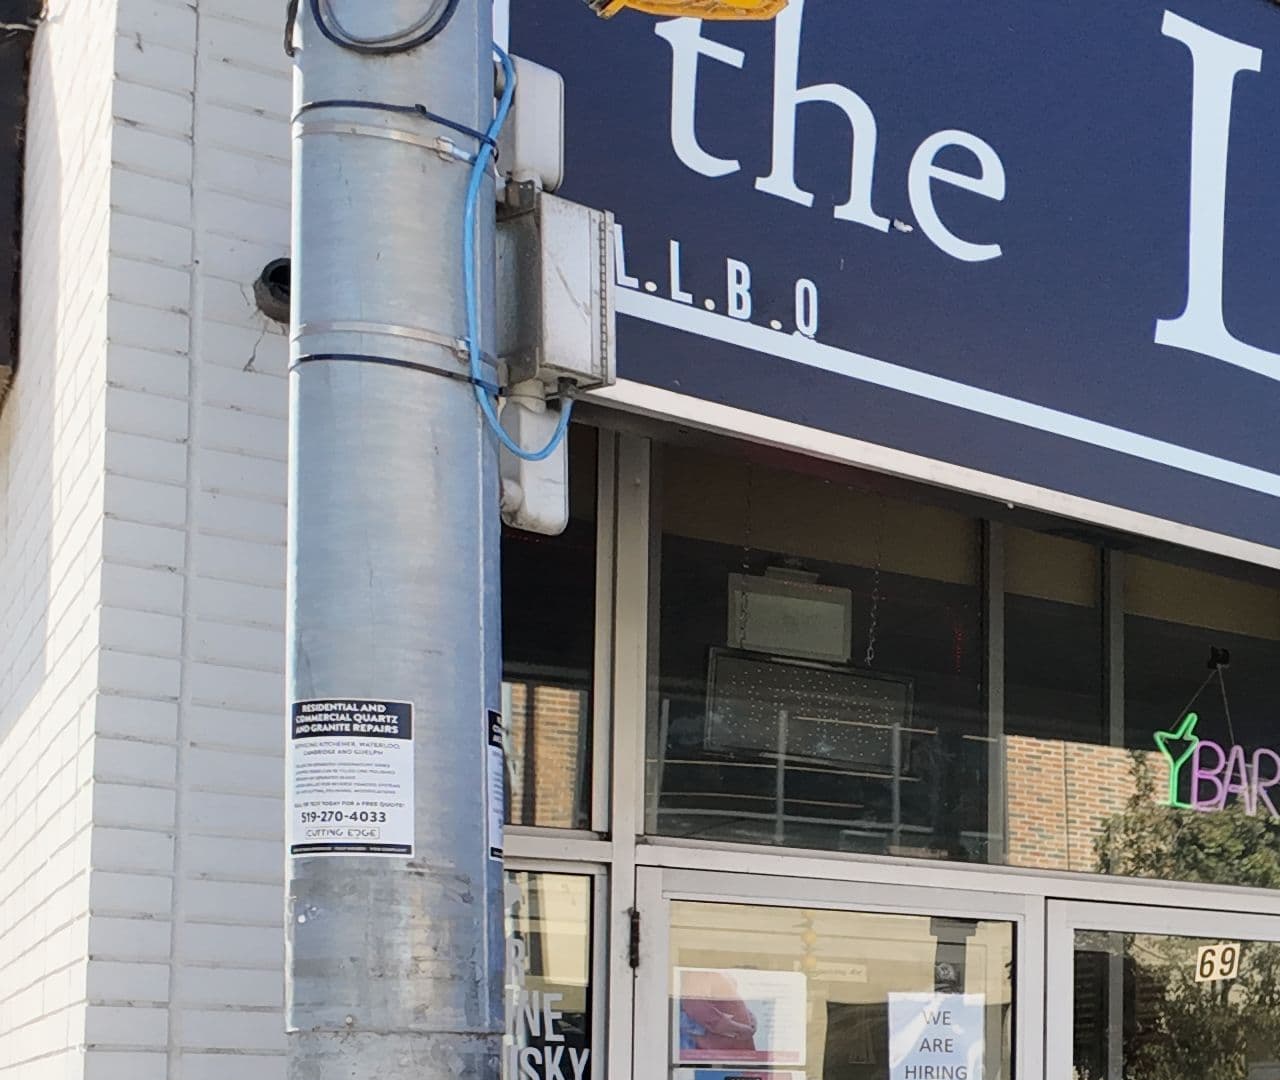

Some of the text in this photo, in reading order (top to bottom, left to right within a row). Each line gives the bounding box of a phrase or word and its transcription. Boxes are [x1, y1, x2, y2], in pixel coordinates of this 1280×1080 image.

[654, 0, 1006, 262] the
[302, 704, 387, 713] RESIDENTIAL AND
[296, 714, 398, 724] COMMERCIAL QUARTZ
[296, 723, 399, 734] AND GRANITE REPAIRS
[301, 811, 387, 823] 519-270-4033
[306, 828, 344, 838] CUTTING
[1199, 946, 1236, 979] 69
[922, 1010, 952, 1025] WE
[919, 1038, 954, 1053] ARE
[904, 1065, 968, 1080] HIRING
